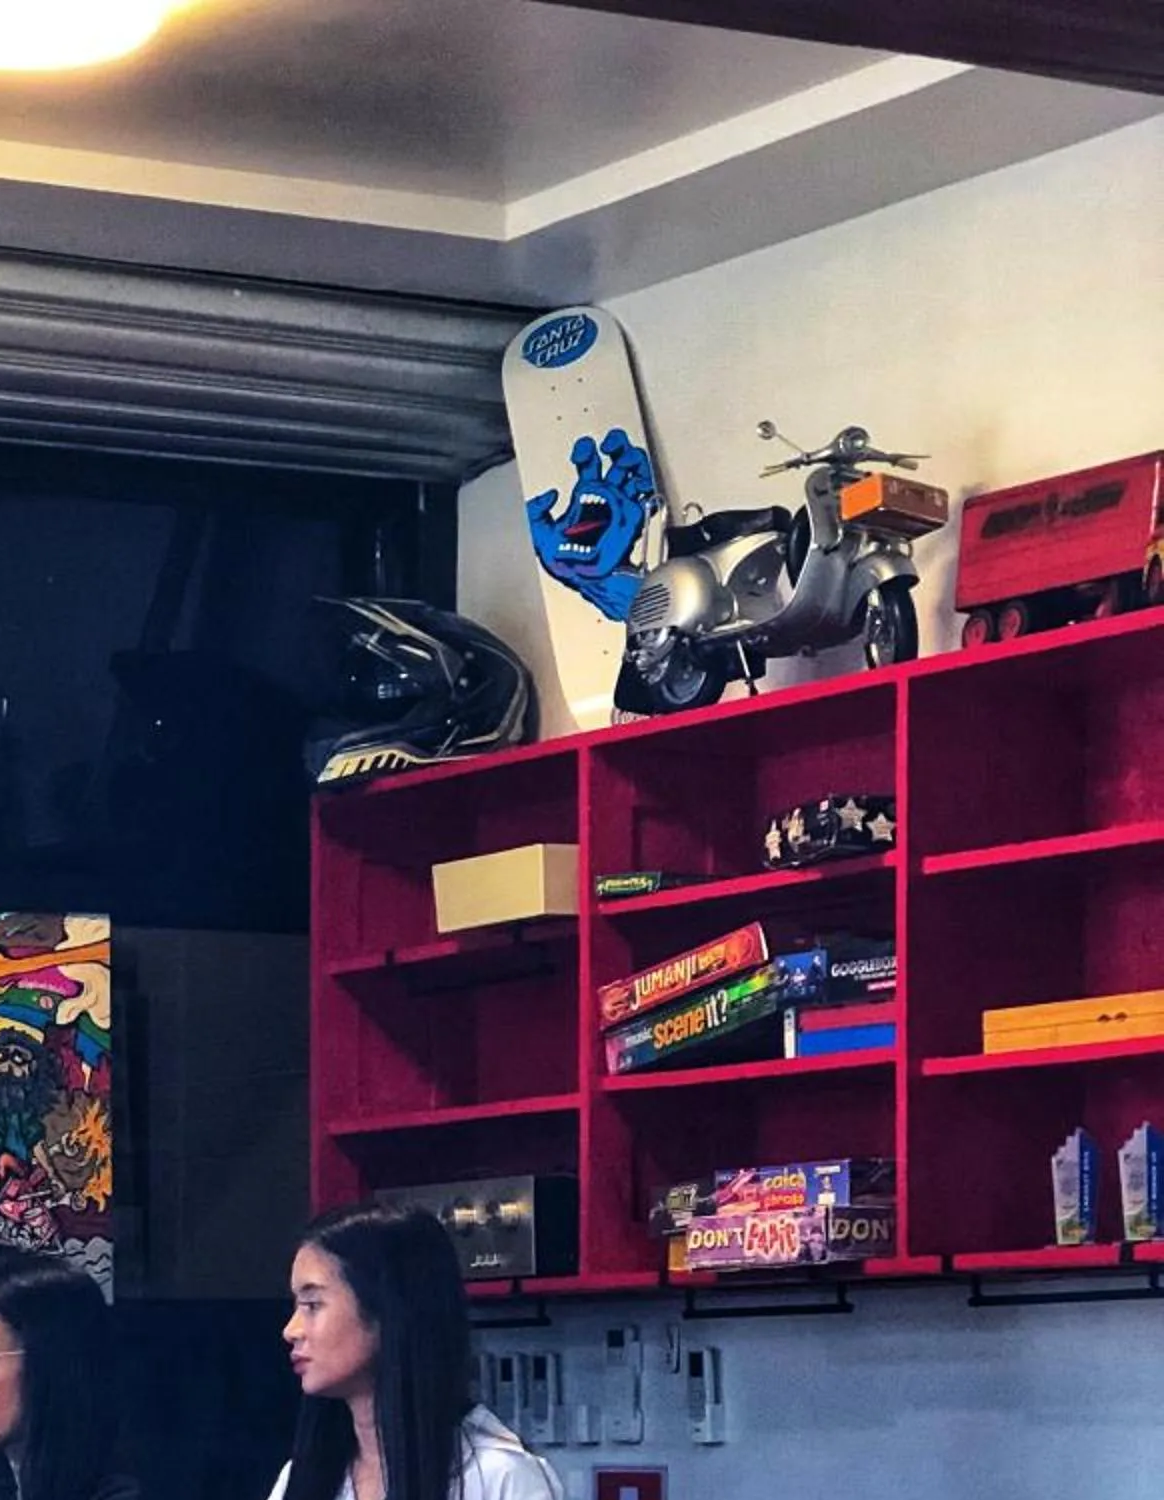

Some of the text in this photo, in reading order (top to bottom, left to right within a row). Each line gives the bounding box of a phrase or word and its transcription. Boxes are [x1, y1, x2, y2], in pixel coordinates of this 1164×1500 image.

[526, 315, 586, 355] SANTA
[537, 328, 585, 366] CRUZ
[630, 954, 698, 1010] JUMANJI
[653, 1005, 706, 1049] scene
[705, 989, 728, 1029] it?
[688, 1227, 744, 1250] DON'T
[832, 1218, 896, 1241] DON'
